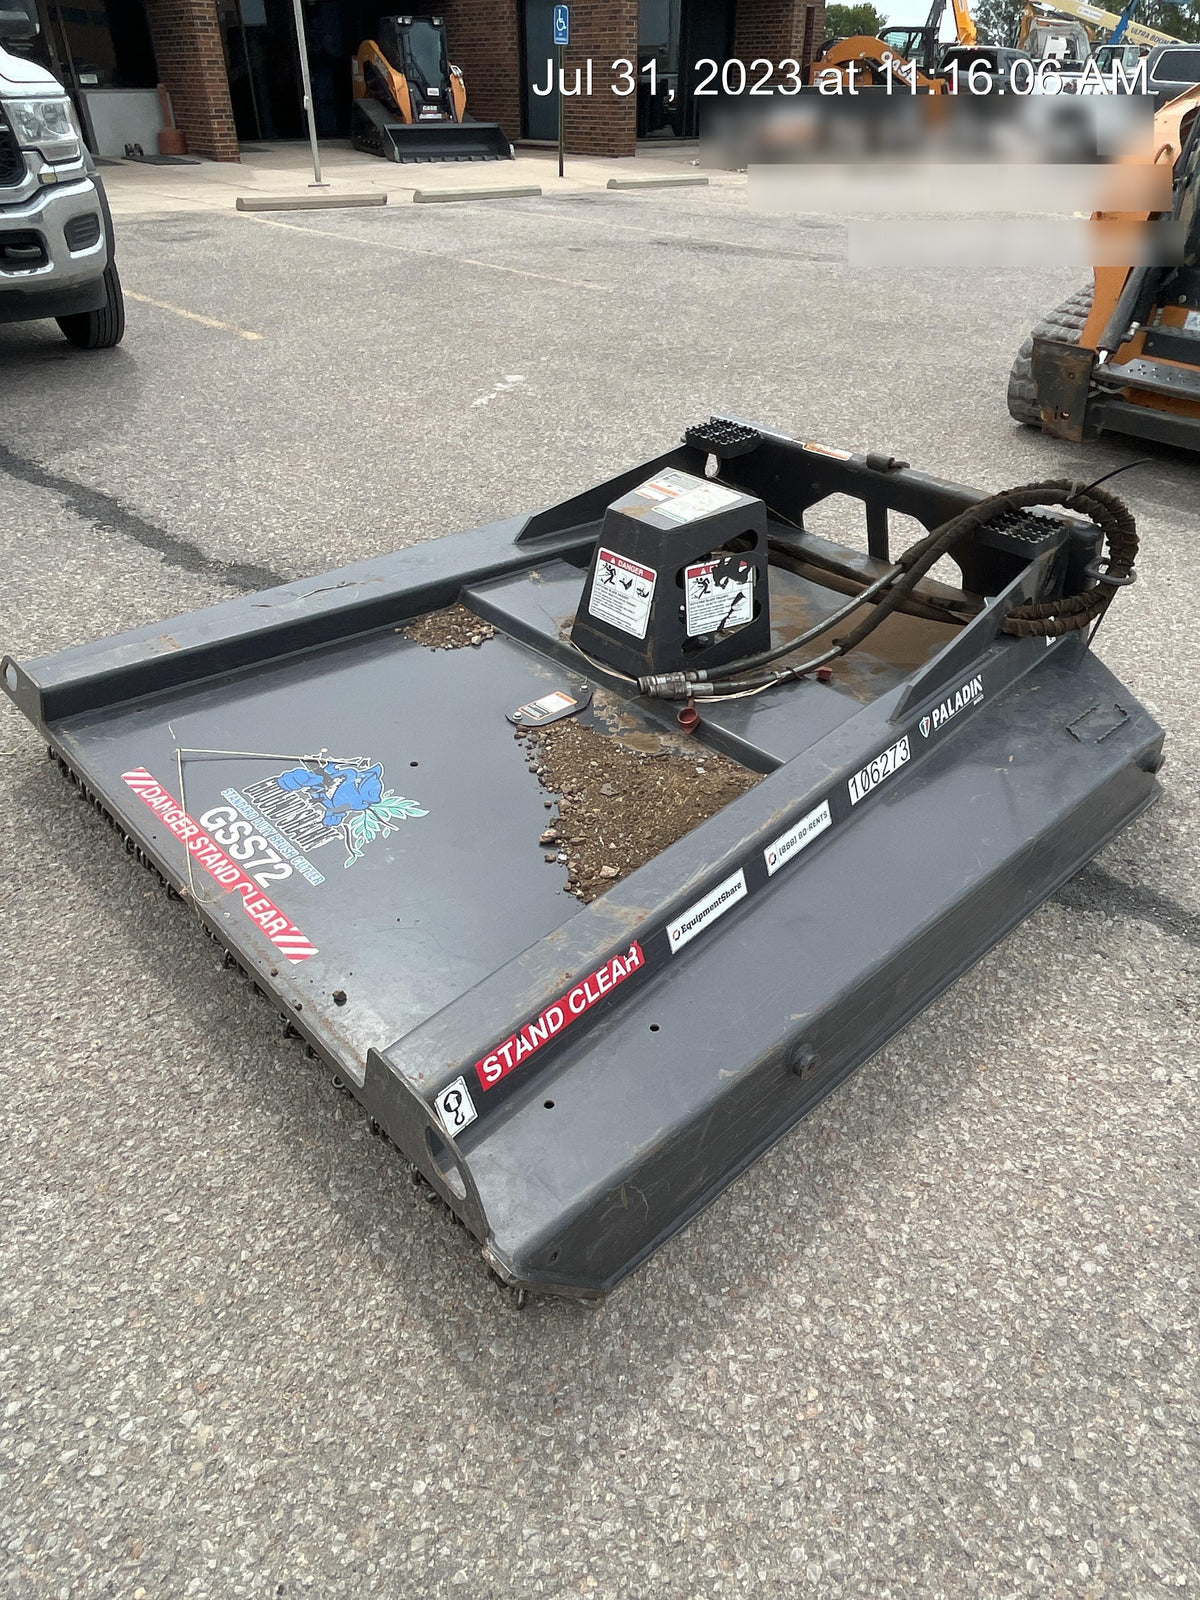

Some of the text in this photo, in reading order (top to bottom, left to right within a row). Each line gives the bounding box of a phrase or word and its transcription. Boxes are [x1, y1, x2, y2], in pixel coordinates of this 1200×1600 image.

[1131, 27, 1150, 39] ULTRA
[617, 560, 644, 576] DANGER
[850, 739, 909, 799] 106273
[141, 786, 288, 936] DANGER STAND CLEAR
[199, 806, 293, 889] GSS72
[221, 788, 326, 886] STANDARD DUTY BRUSH CUTTER
[779, 835, 797, 856] (888)
[681, 881, 742, 934] EquipmentShare
[482, 946, 640, 1082] STAND CLEAR
